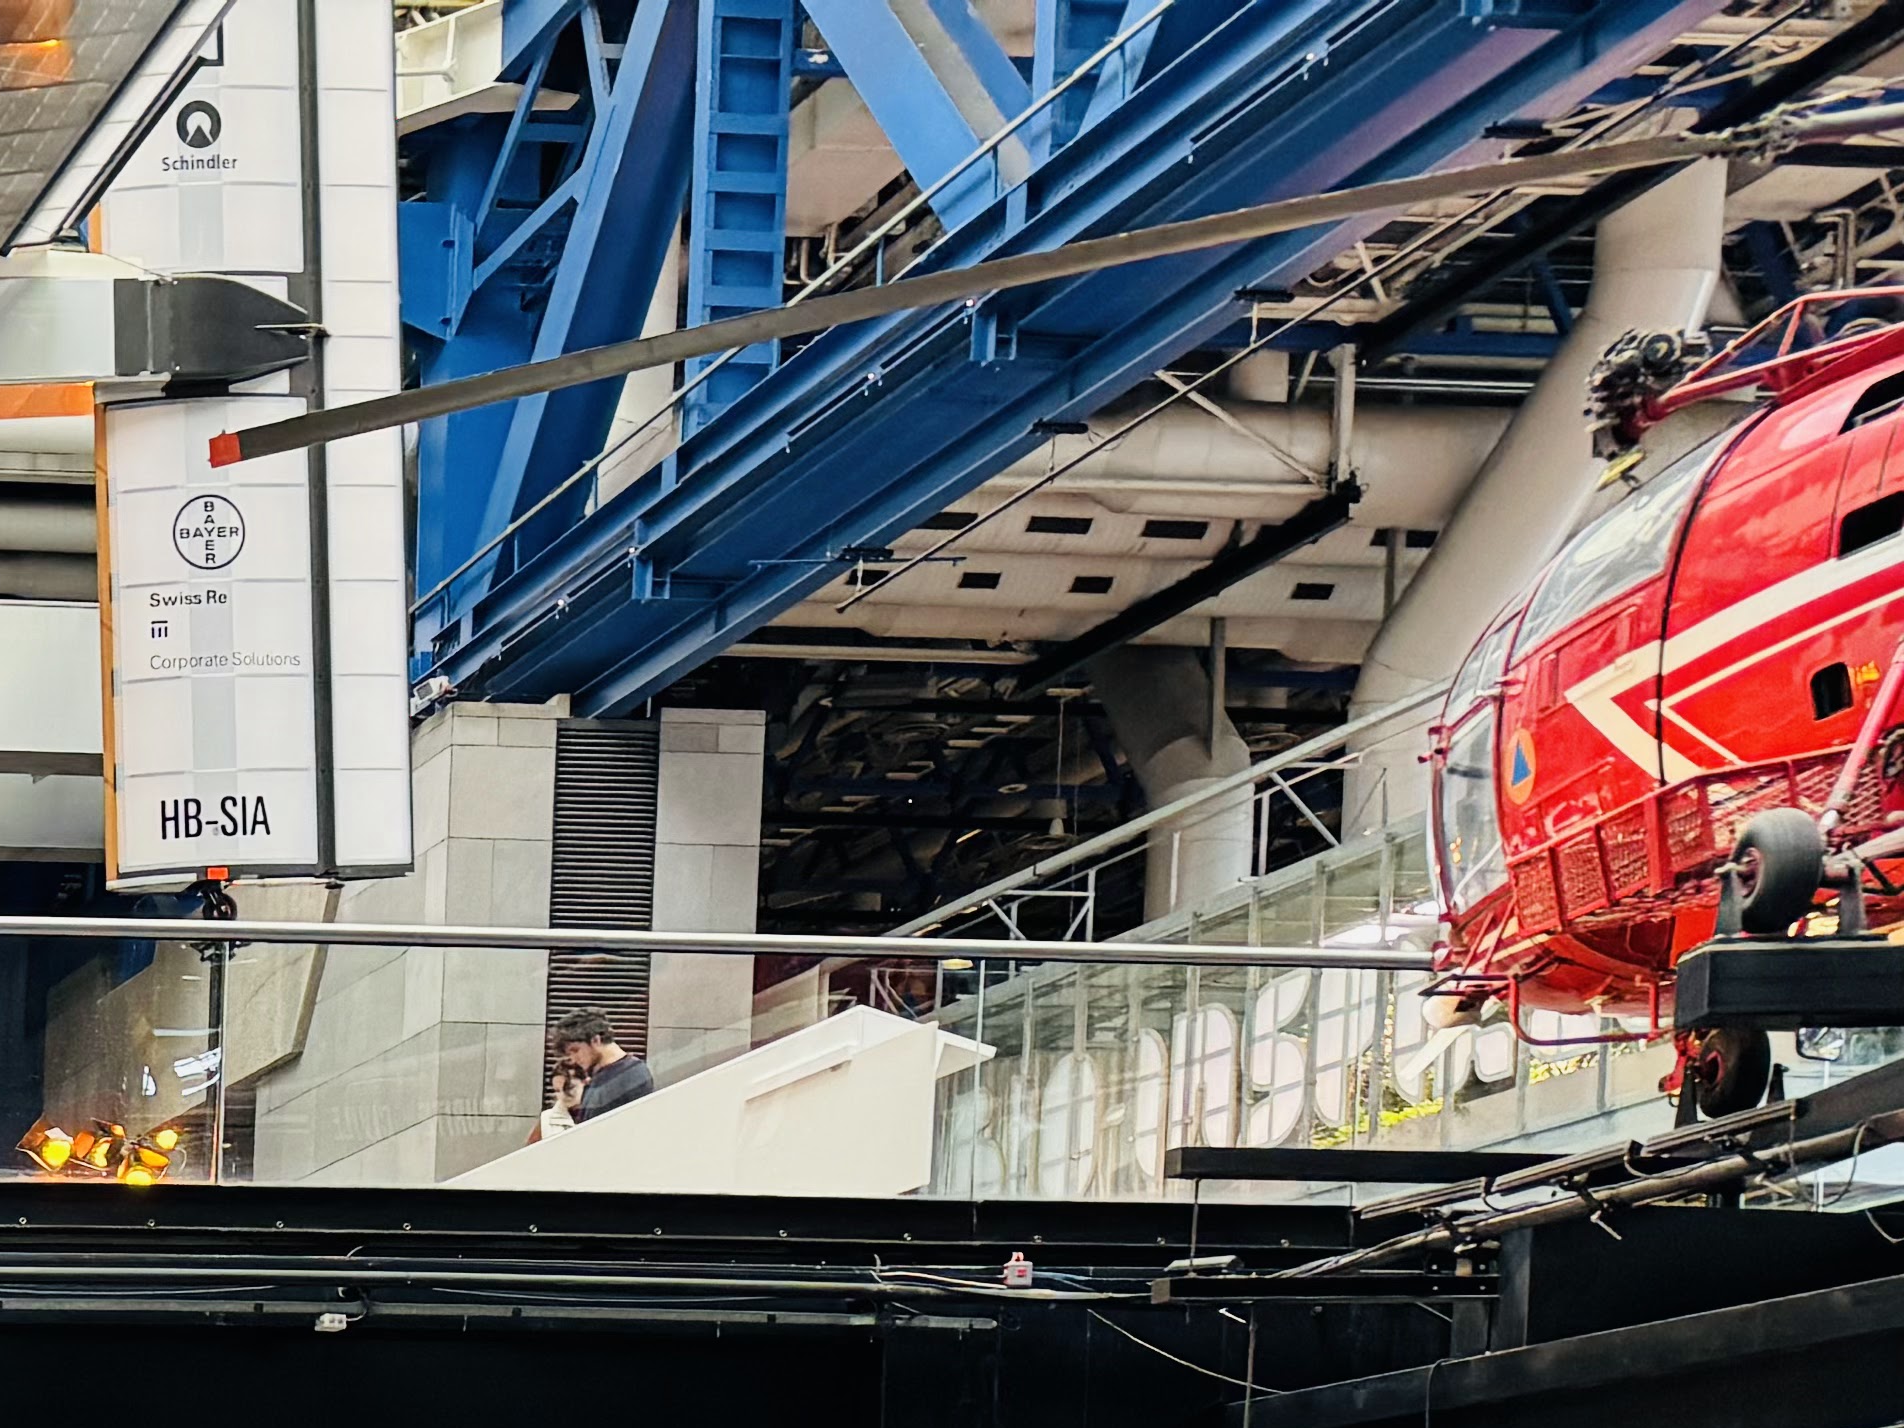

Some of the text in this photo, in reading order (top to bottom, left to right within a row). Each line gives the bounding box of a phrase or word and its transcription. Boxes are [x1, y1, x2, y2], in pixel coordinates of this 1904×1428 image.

[162, 154, 239, 172] Schindler
[179, 526, 240, 539] BAYER
[203, 500, 216, 564] BAYER
[149, 589, 228, 608] Swiss Re
[149, 650, 301, 671] Corporate Solutions
[160, 795, 271, 840] HB-SIA
